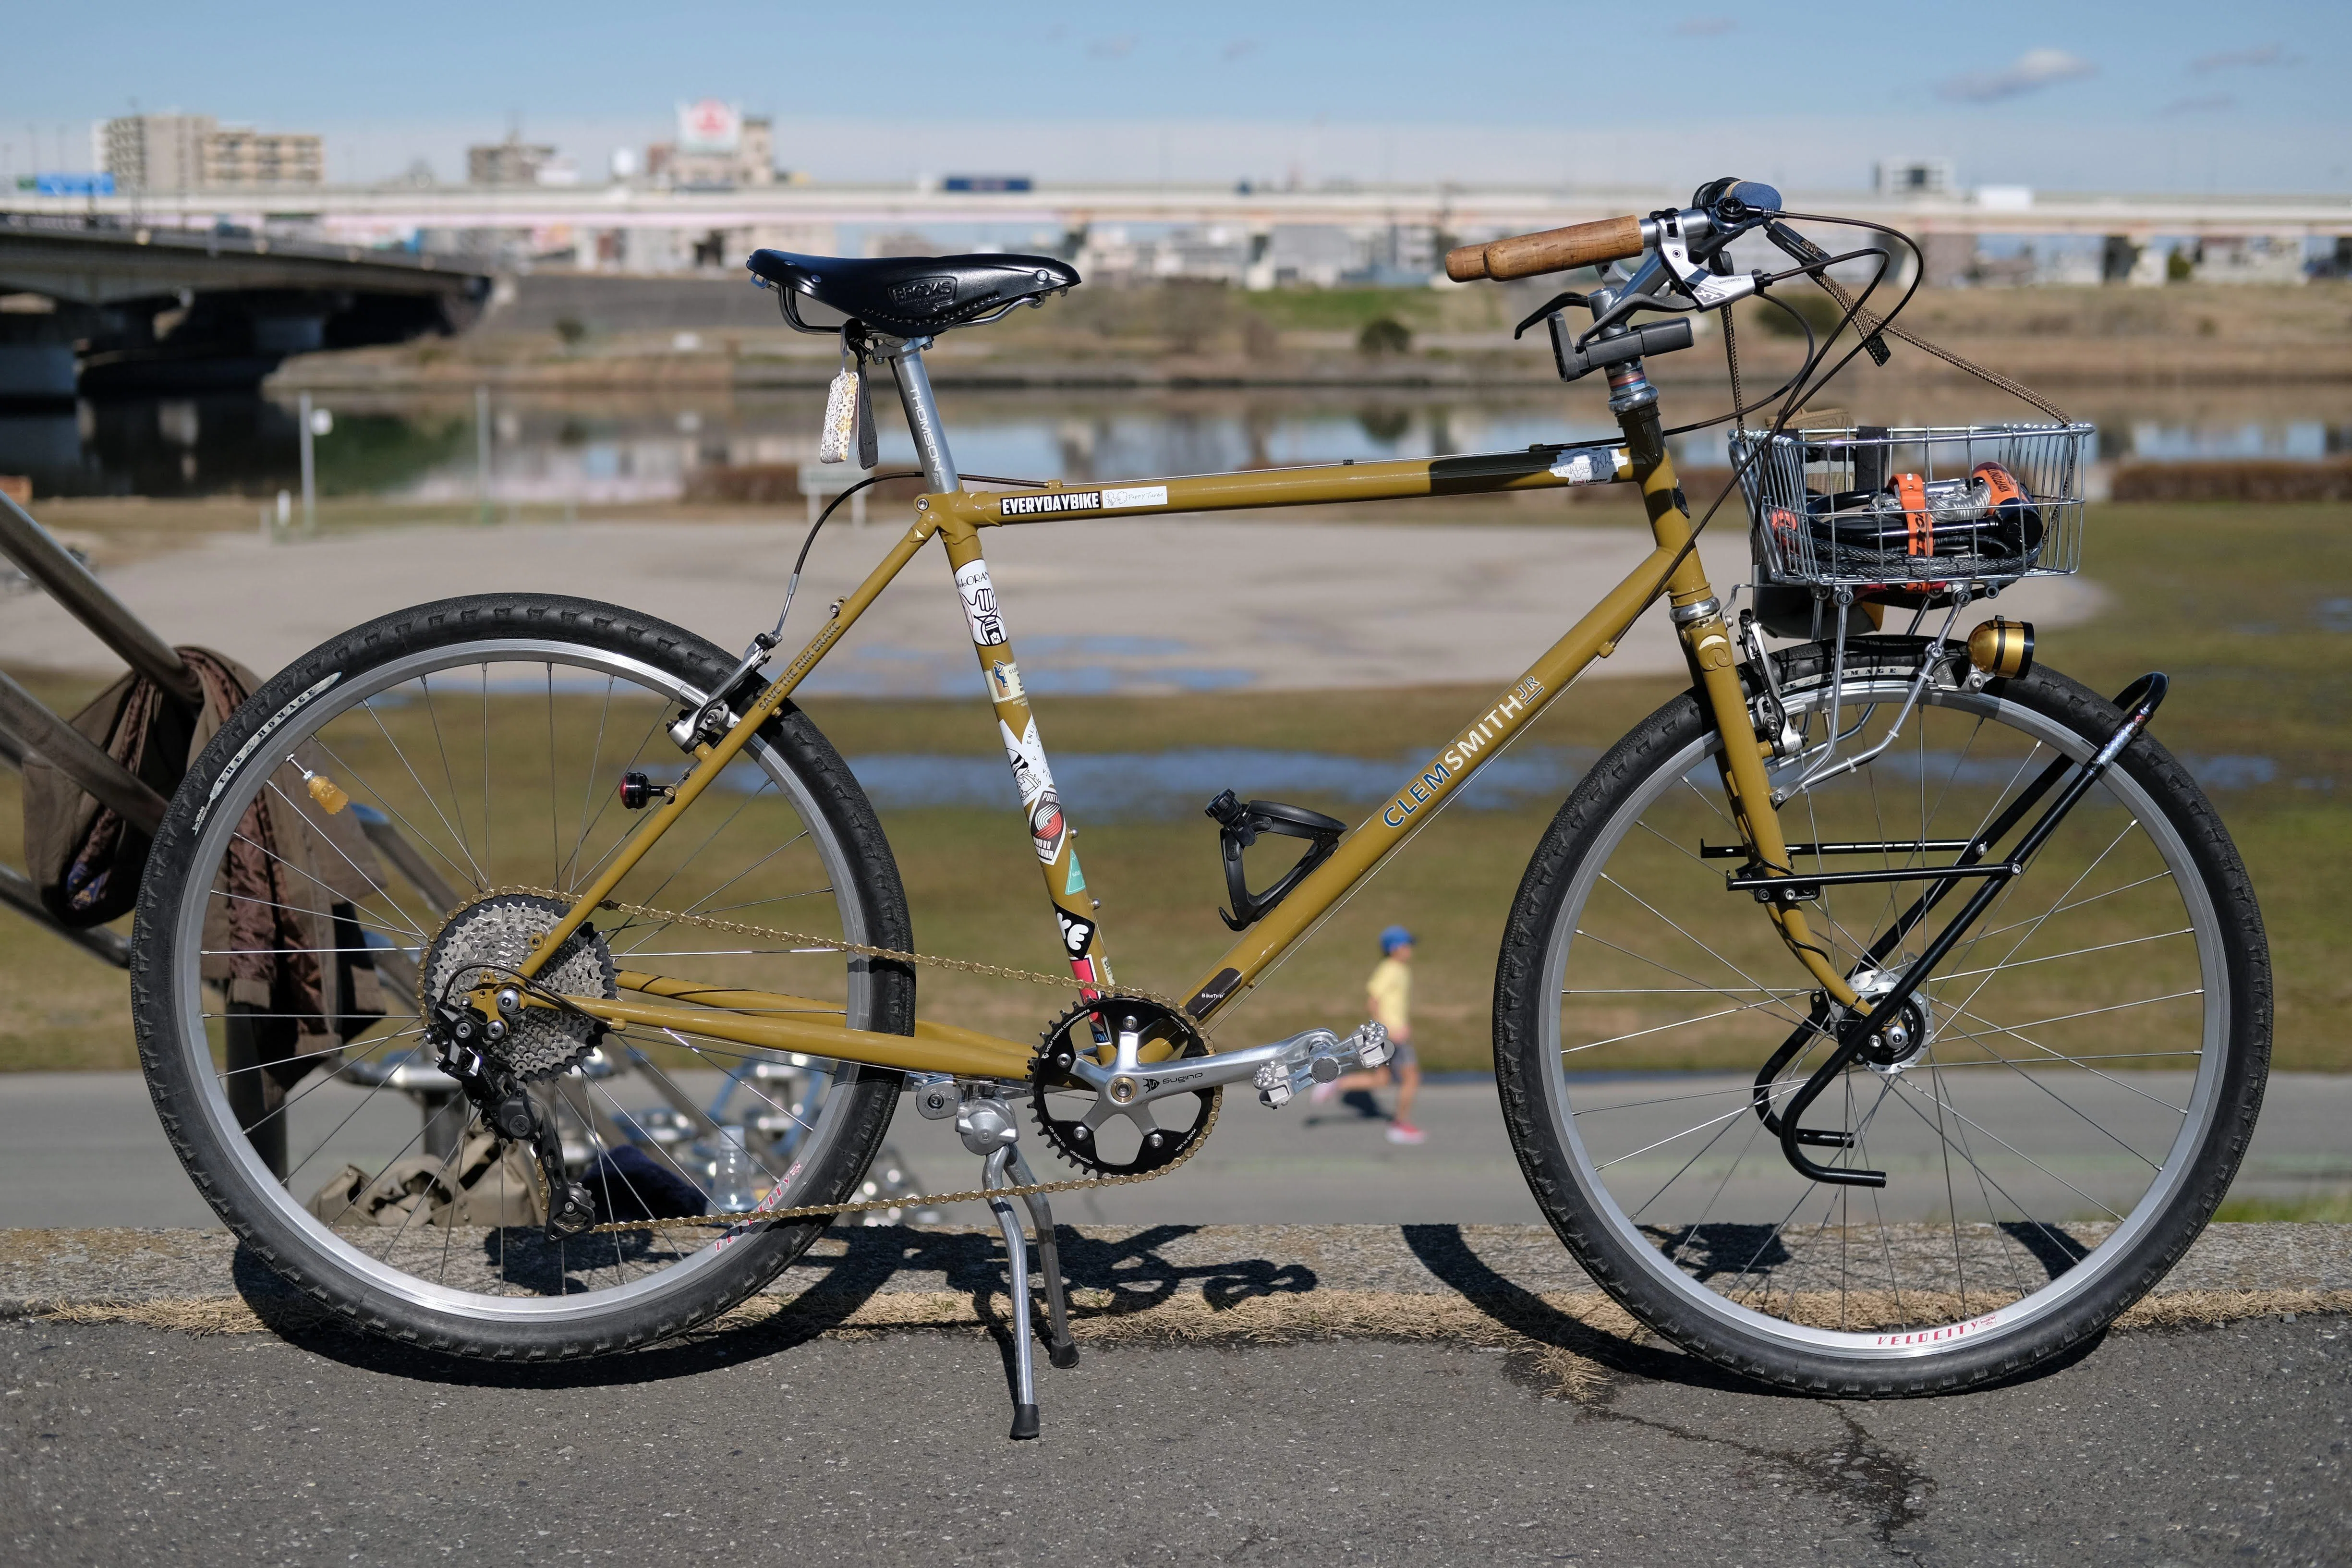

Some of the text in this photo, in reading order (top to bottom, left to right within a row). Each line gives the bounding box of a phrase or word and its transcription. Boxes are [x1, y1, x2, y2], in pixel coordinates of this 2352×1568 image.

[910, 384, 943, 472] THOMSON
[1003, 492, 1099, 514] EVERYDAYBIKE
[759, 621, 841, 710] SAVE THE RIM BRAKE
[218, 690, 315, 785] THE HOMAGE
[1045, 1009, 1091, 1052] WOLF TOOTH COMPONENTS
[480, 1067, 495, 1092] DEORE
[1163, 1072, 1203, 1084] Sugino
[1053, 1133, 1061, 1142] BCD
[1187, 1128, 1197, 1140] MADE
[1069, 1150, 1093, 1165] DROP-STOP
[1878, 1321, 1980, 1345] VELOCITY
